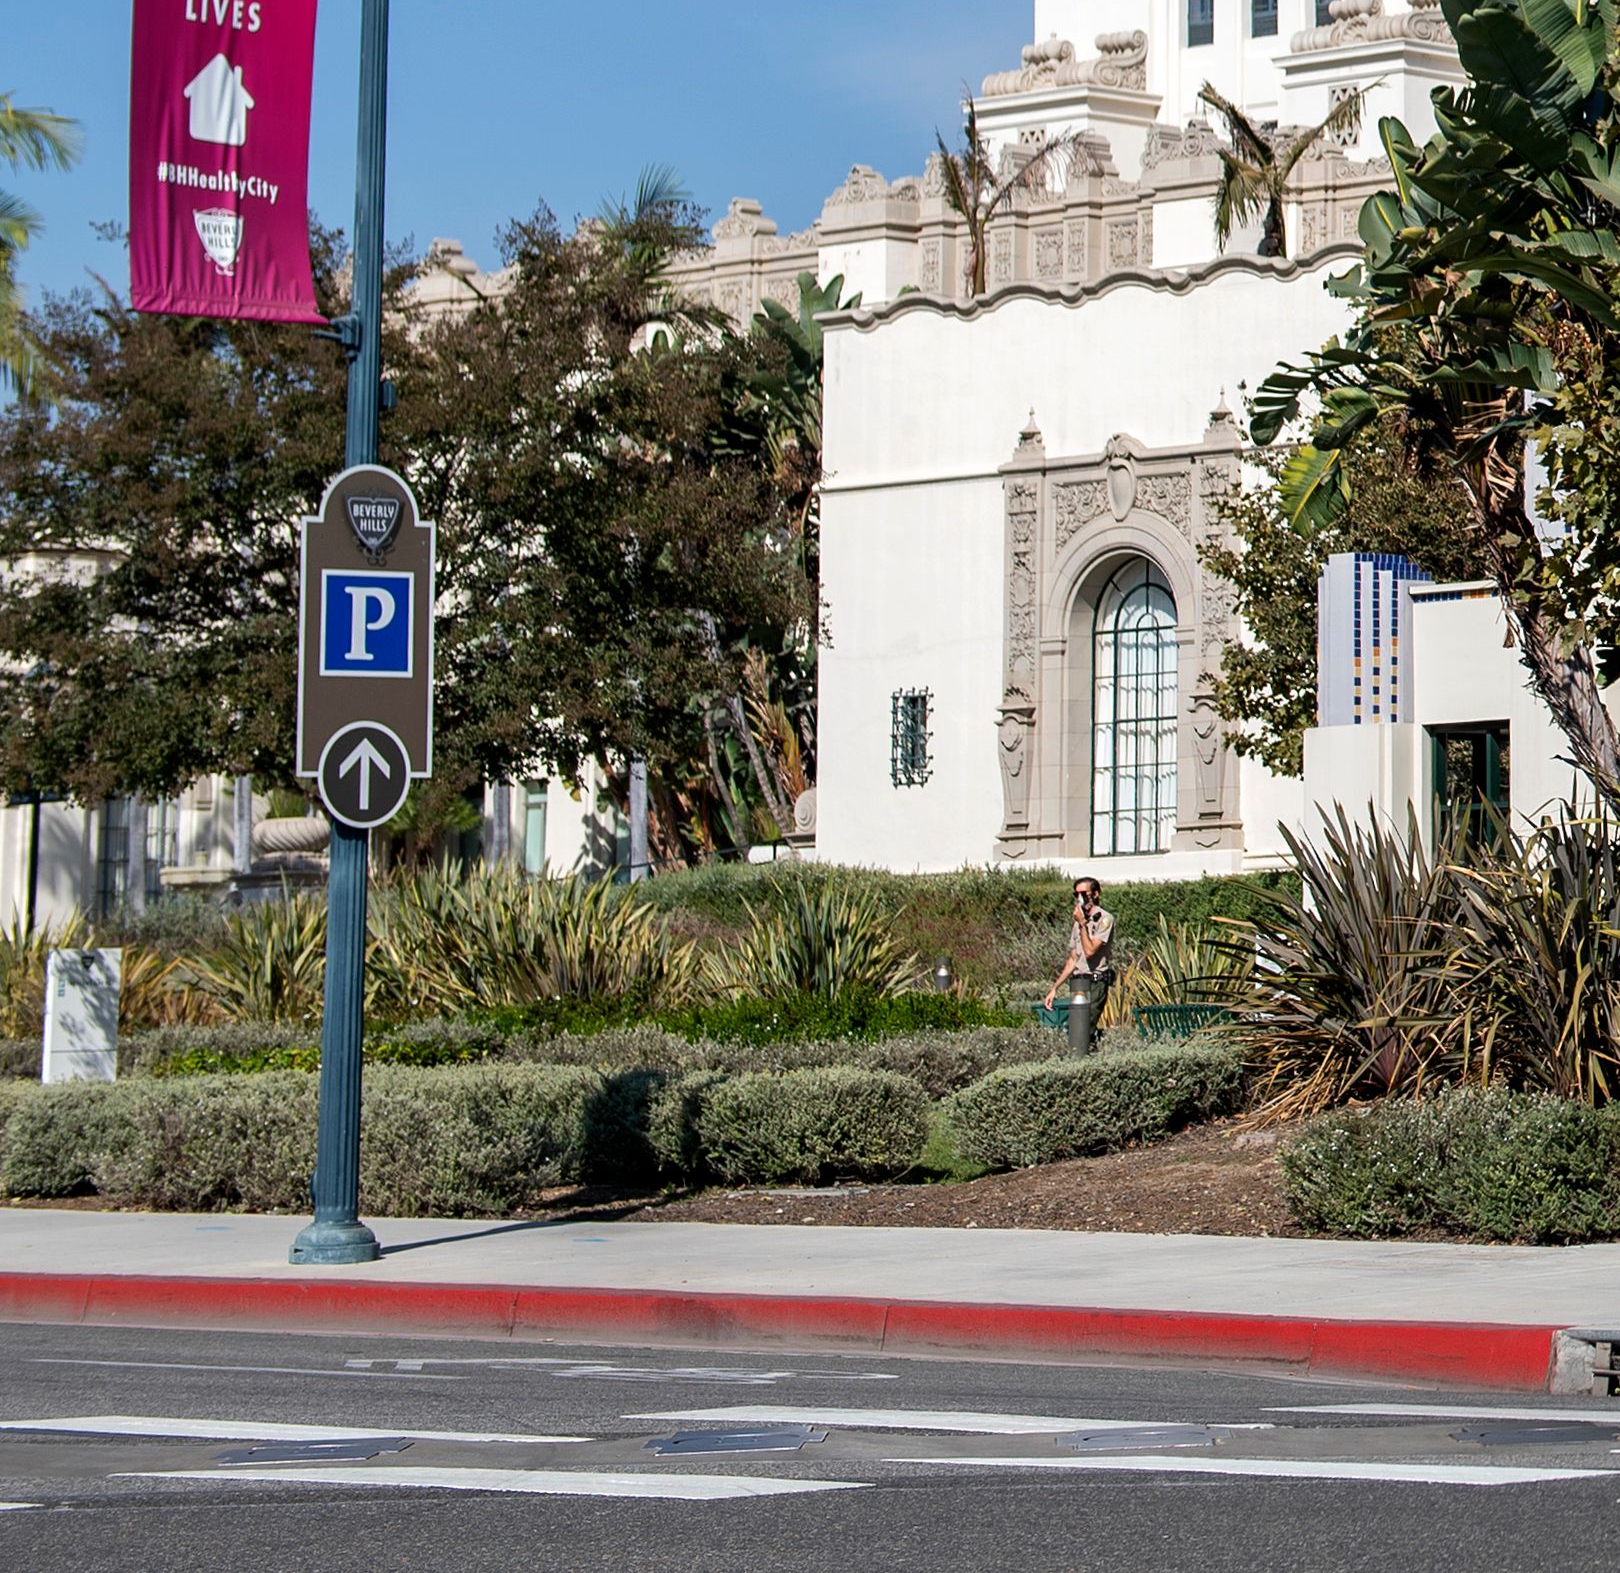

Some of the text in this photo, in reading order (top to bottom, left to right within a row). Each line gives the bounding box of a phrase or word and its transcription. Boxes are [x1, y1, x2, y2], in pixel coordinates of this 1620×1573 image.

[353, 503, 395, 518] BEVERLY
[360, 518, 387, 533] HILLS
[344, 586, 396, 661] P
